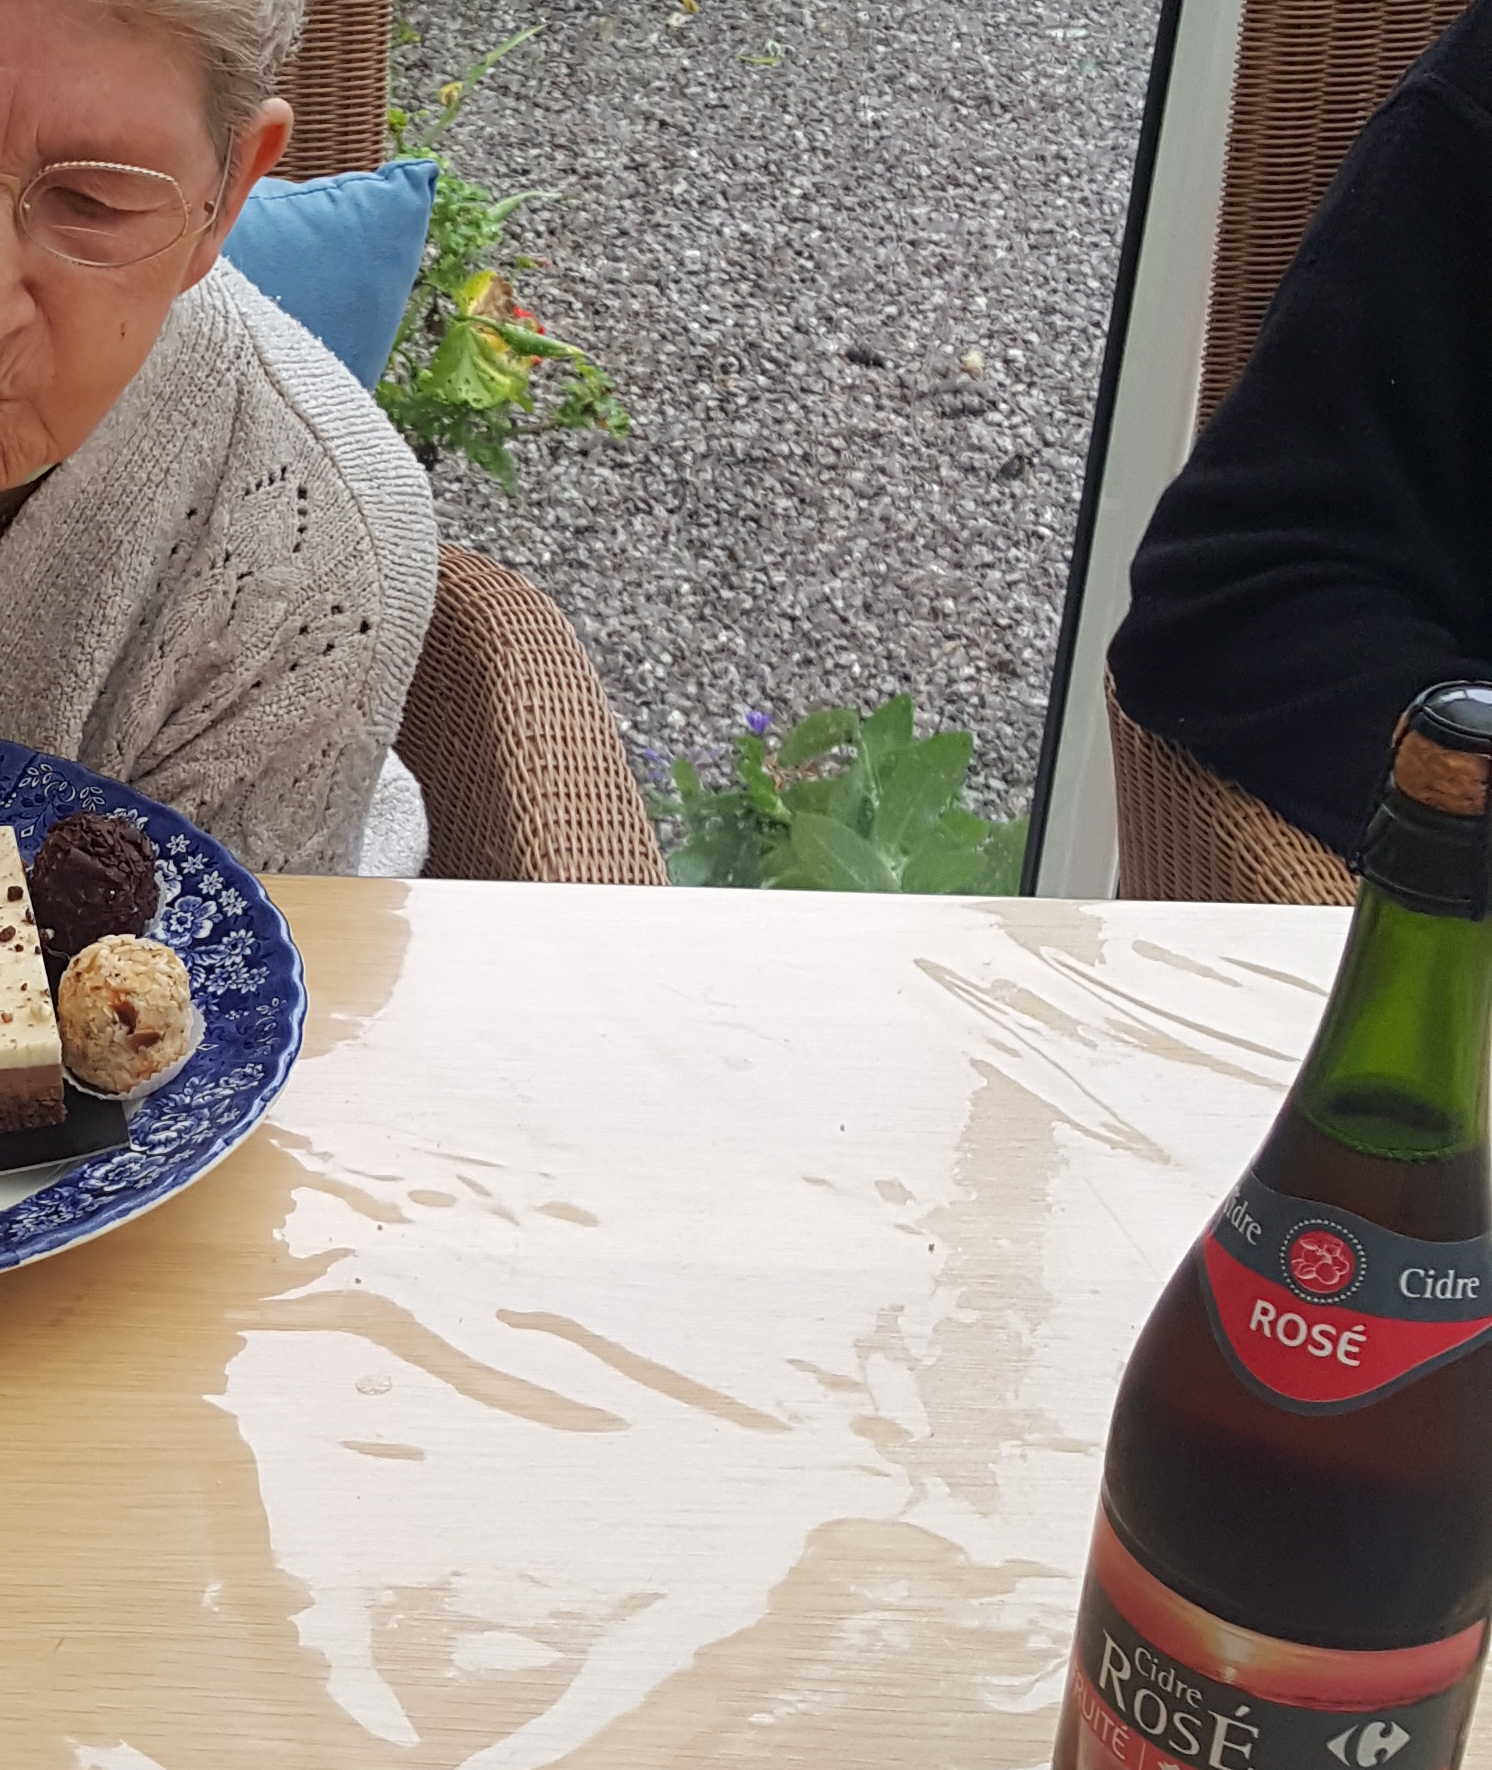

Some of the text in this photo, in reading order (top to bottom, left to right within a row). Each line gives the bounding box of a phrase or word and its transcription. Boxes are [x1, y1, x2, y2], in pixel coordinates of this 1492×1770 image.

[1400, 1268, 1481, 1299] Cidre
[1249, 1299, 1367, 1367] ROSÉ
[1134, 1647, 1203, 1709] Cidre
